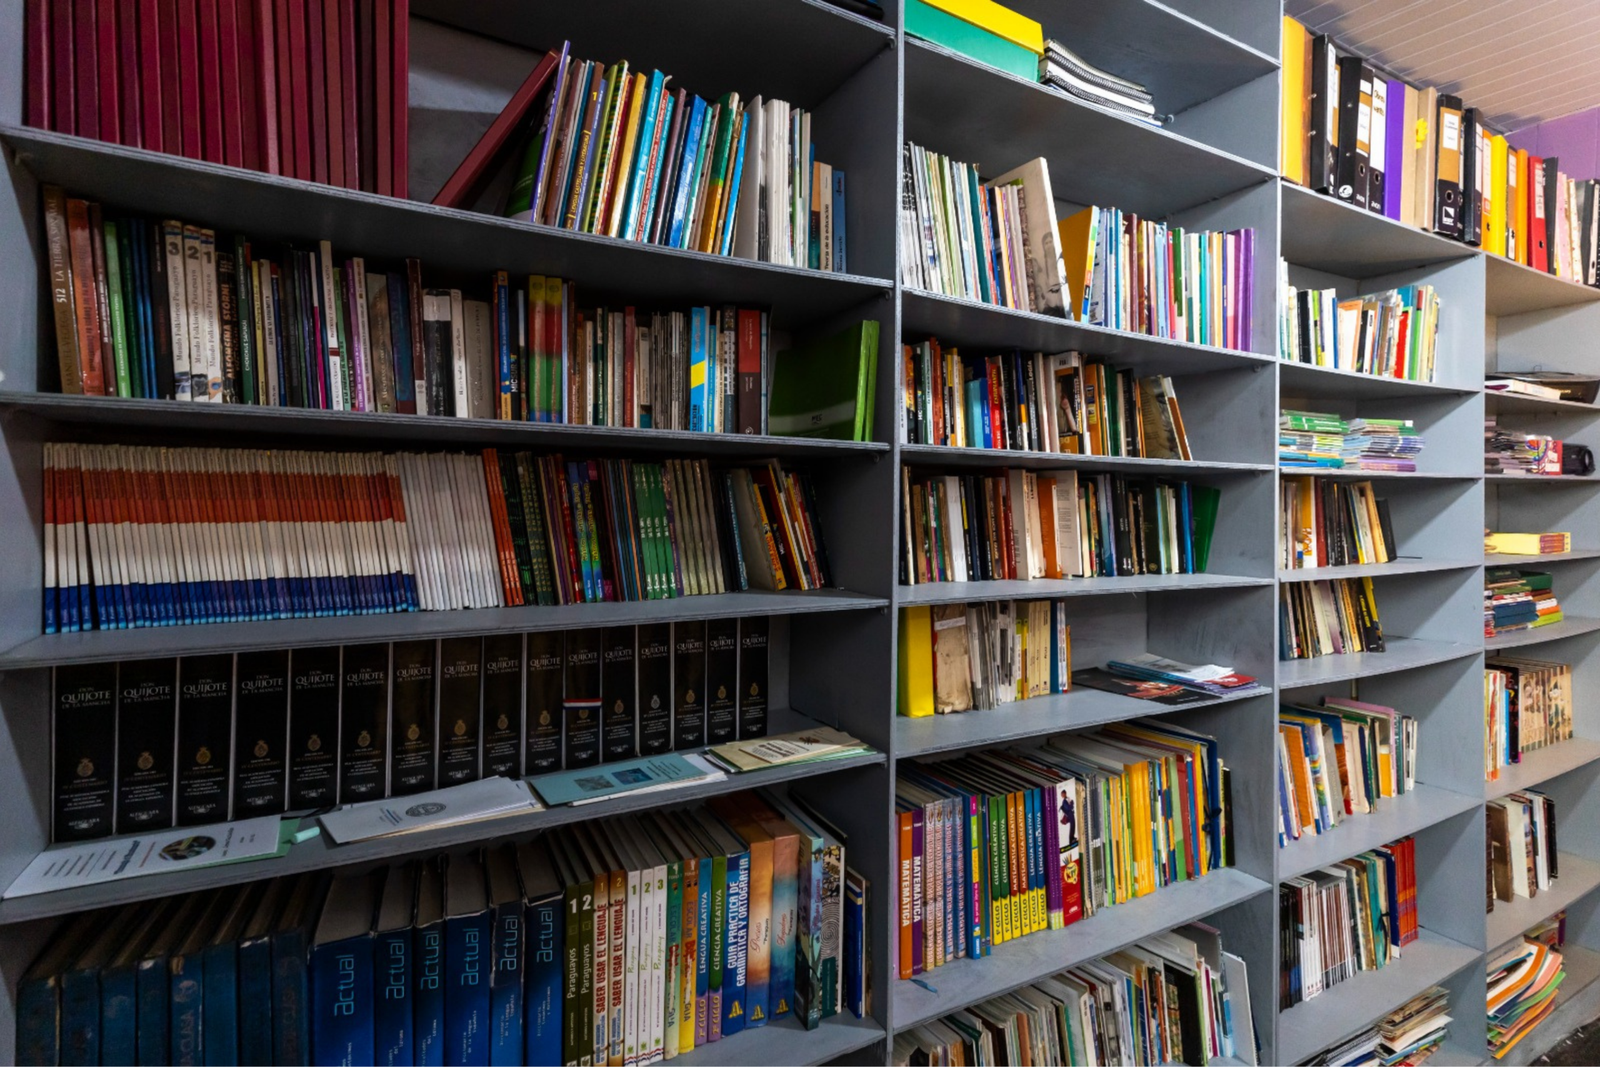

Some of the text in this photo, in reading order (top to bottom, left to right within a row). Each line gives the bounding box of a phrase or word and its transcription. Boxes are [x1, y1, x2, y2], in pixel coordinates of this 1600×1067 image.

[51, 237, 63, 268] TIERRA
[168, 241, 180, 256] 3
[188, 246, 199, 260] 2
[203, 251, 211, 264] 1
[55, 270, 64, 282] LA
[171, 266, 181, 302] Paraguayo
[191, 269, 201, 305] Paraguayo
[56, 288, 67, 303] 512
[205, 274, 214, 309] Paraguayo
[222, 284, 232, 321] STORNI
[175, 337, 183, 361] Mundo
[209, 345, 217, 367] Mundo
[295, 674, 336, 687] QUIJOTE
[347, 671, 385, 684] QUIJOTE
[396, 667, 432, 680] QUIJOTE
[444, 663, 479, 676] QUIJOTE
[61, 690, 112, 705] QUIJOTE
[123, 685, 171, 700] QUIJOTE
[183, 682, 228, 697] QUIJOTE
[241, 678, 285, 693] QUIJOTE
[644, 882, 651, 893] 2
[658, 879, 664, 890] 3
[901, 859, 912, 927] MATEMÁTICA
[912, 855, 922, 923] MATEMÁTICA
[568, 898, 578, 914] 1
[581, 894, 592, 910] 2
[536, 907, 553, 963] actual
[699, 892, 708, 974] LENGUA CREATIVA
[713, 889, 722, 971] CIENCIA CREATIVA
[727, 881, 739, 969] GUIA PRACTICA DE
[736, 857, 749, 987] GRAMATICA Y ORTOGRAFIA
[461, 928, 479, 986] actual
[500, 915, 518, 971] actual
[613, 897, 624, 1007] SABER USAR EL LENGUAJE
[640, 943, 651, 971] Paraguay
[653, 936, 664, 970] Paraguay
[386, 940, 405, 999] actual
[421, 931, 440, 990] actual
[566, 948, 580, 999] Paraguayos
[581, 944, 594, 995] Paraguayos
[596, 903, 607, 1014] SABER USAR EL LENGUAJE
[627, 945, 638, 974] Paraguay
[334, 954, 355, 1017] actual
[712, 995, 720, 1023] CICLO
